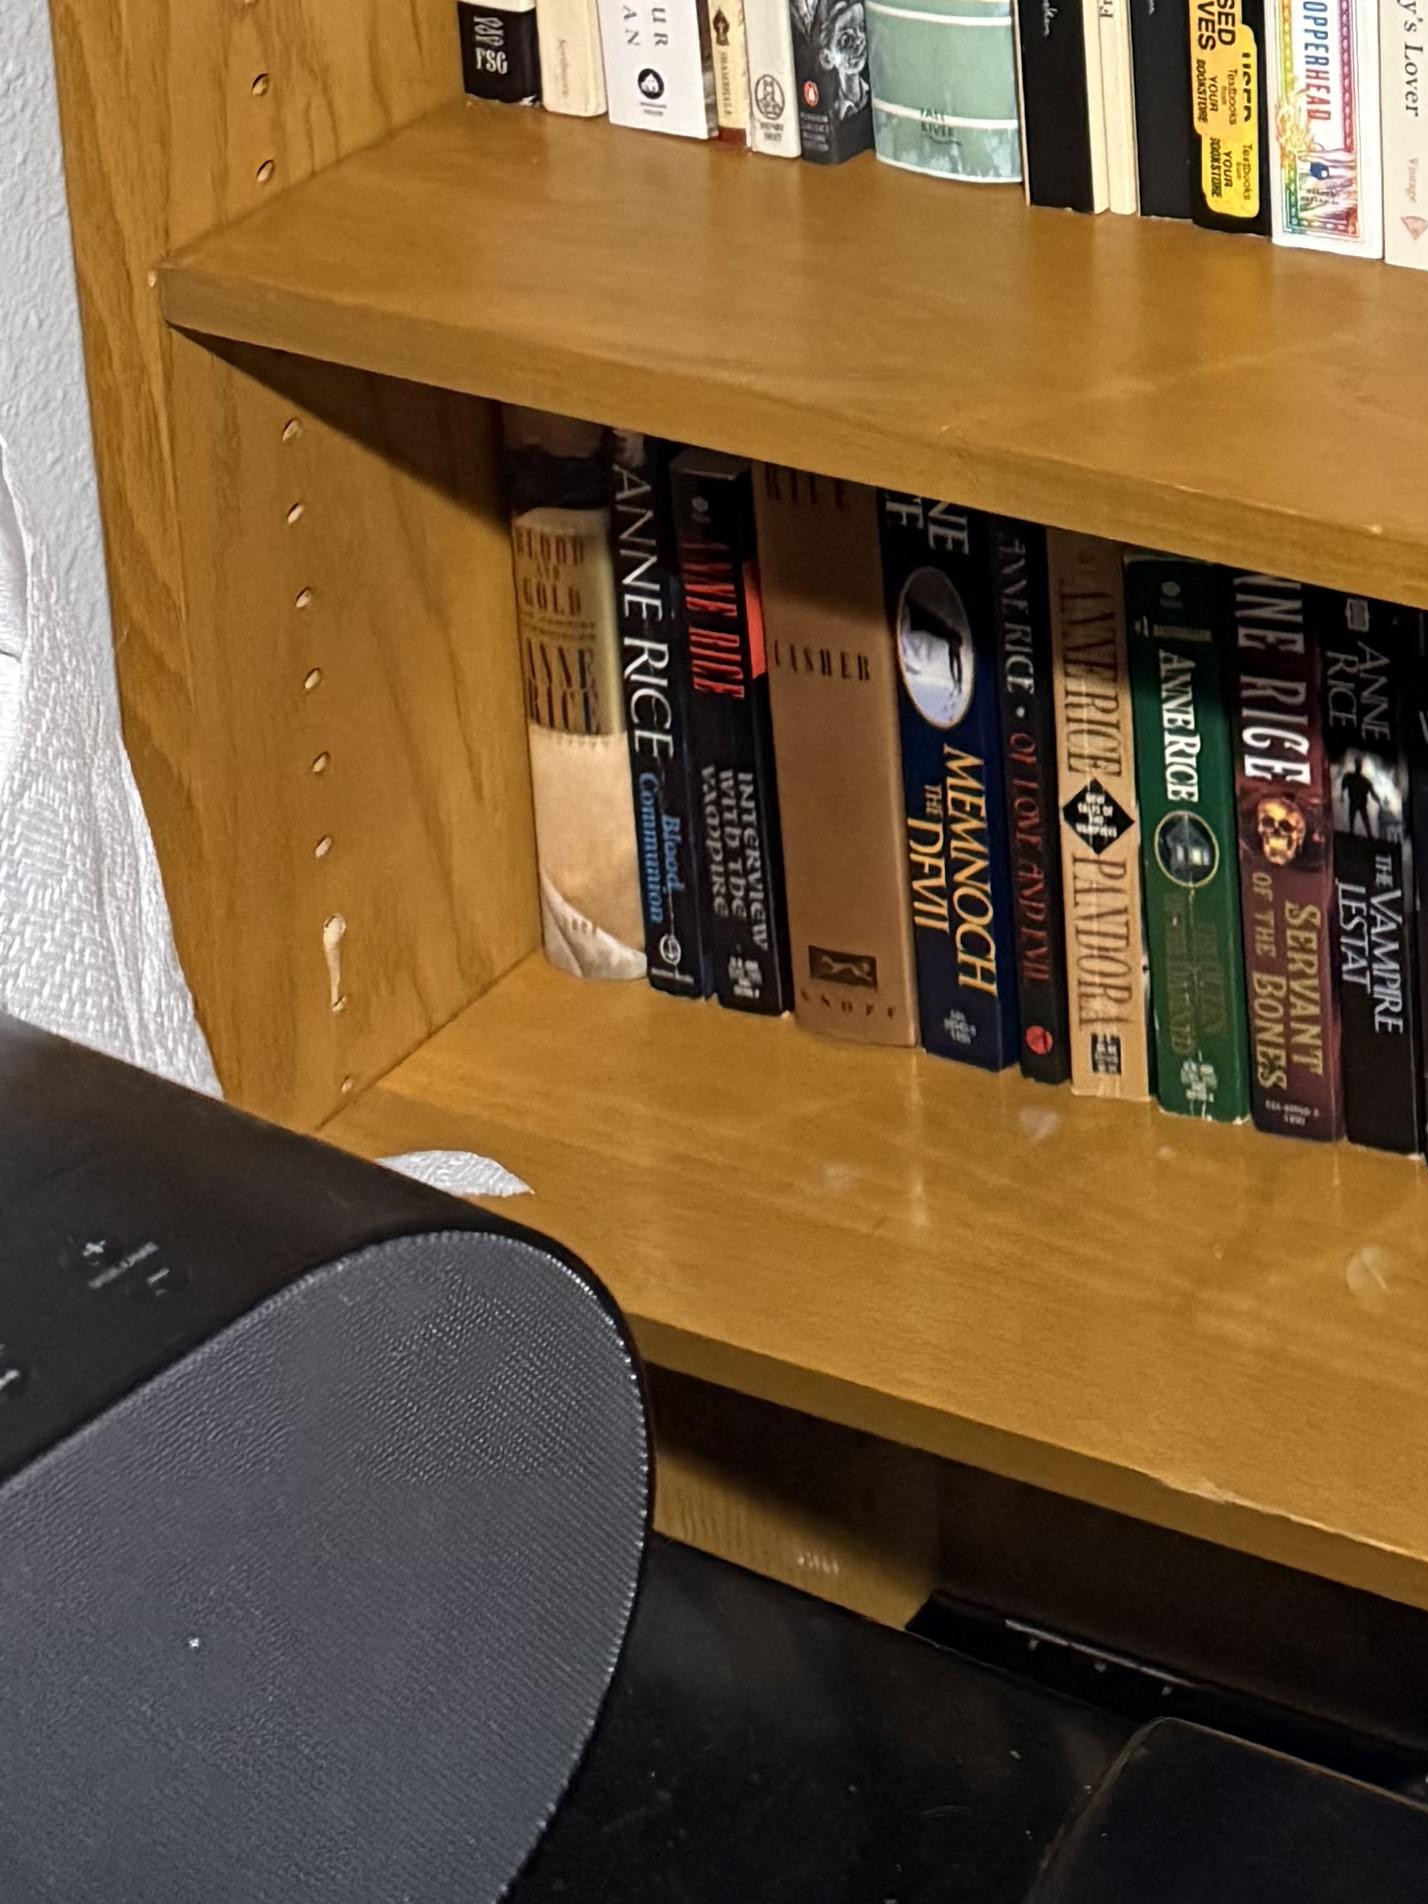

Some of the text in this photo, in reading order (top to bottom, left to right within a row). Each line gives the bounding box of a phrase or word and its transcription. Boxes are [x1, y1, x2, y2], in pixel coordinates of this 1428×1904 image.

[613, 464, 676, 761] ANNE RICE
[943, 742, 998, 998] MEMNOCH
